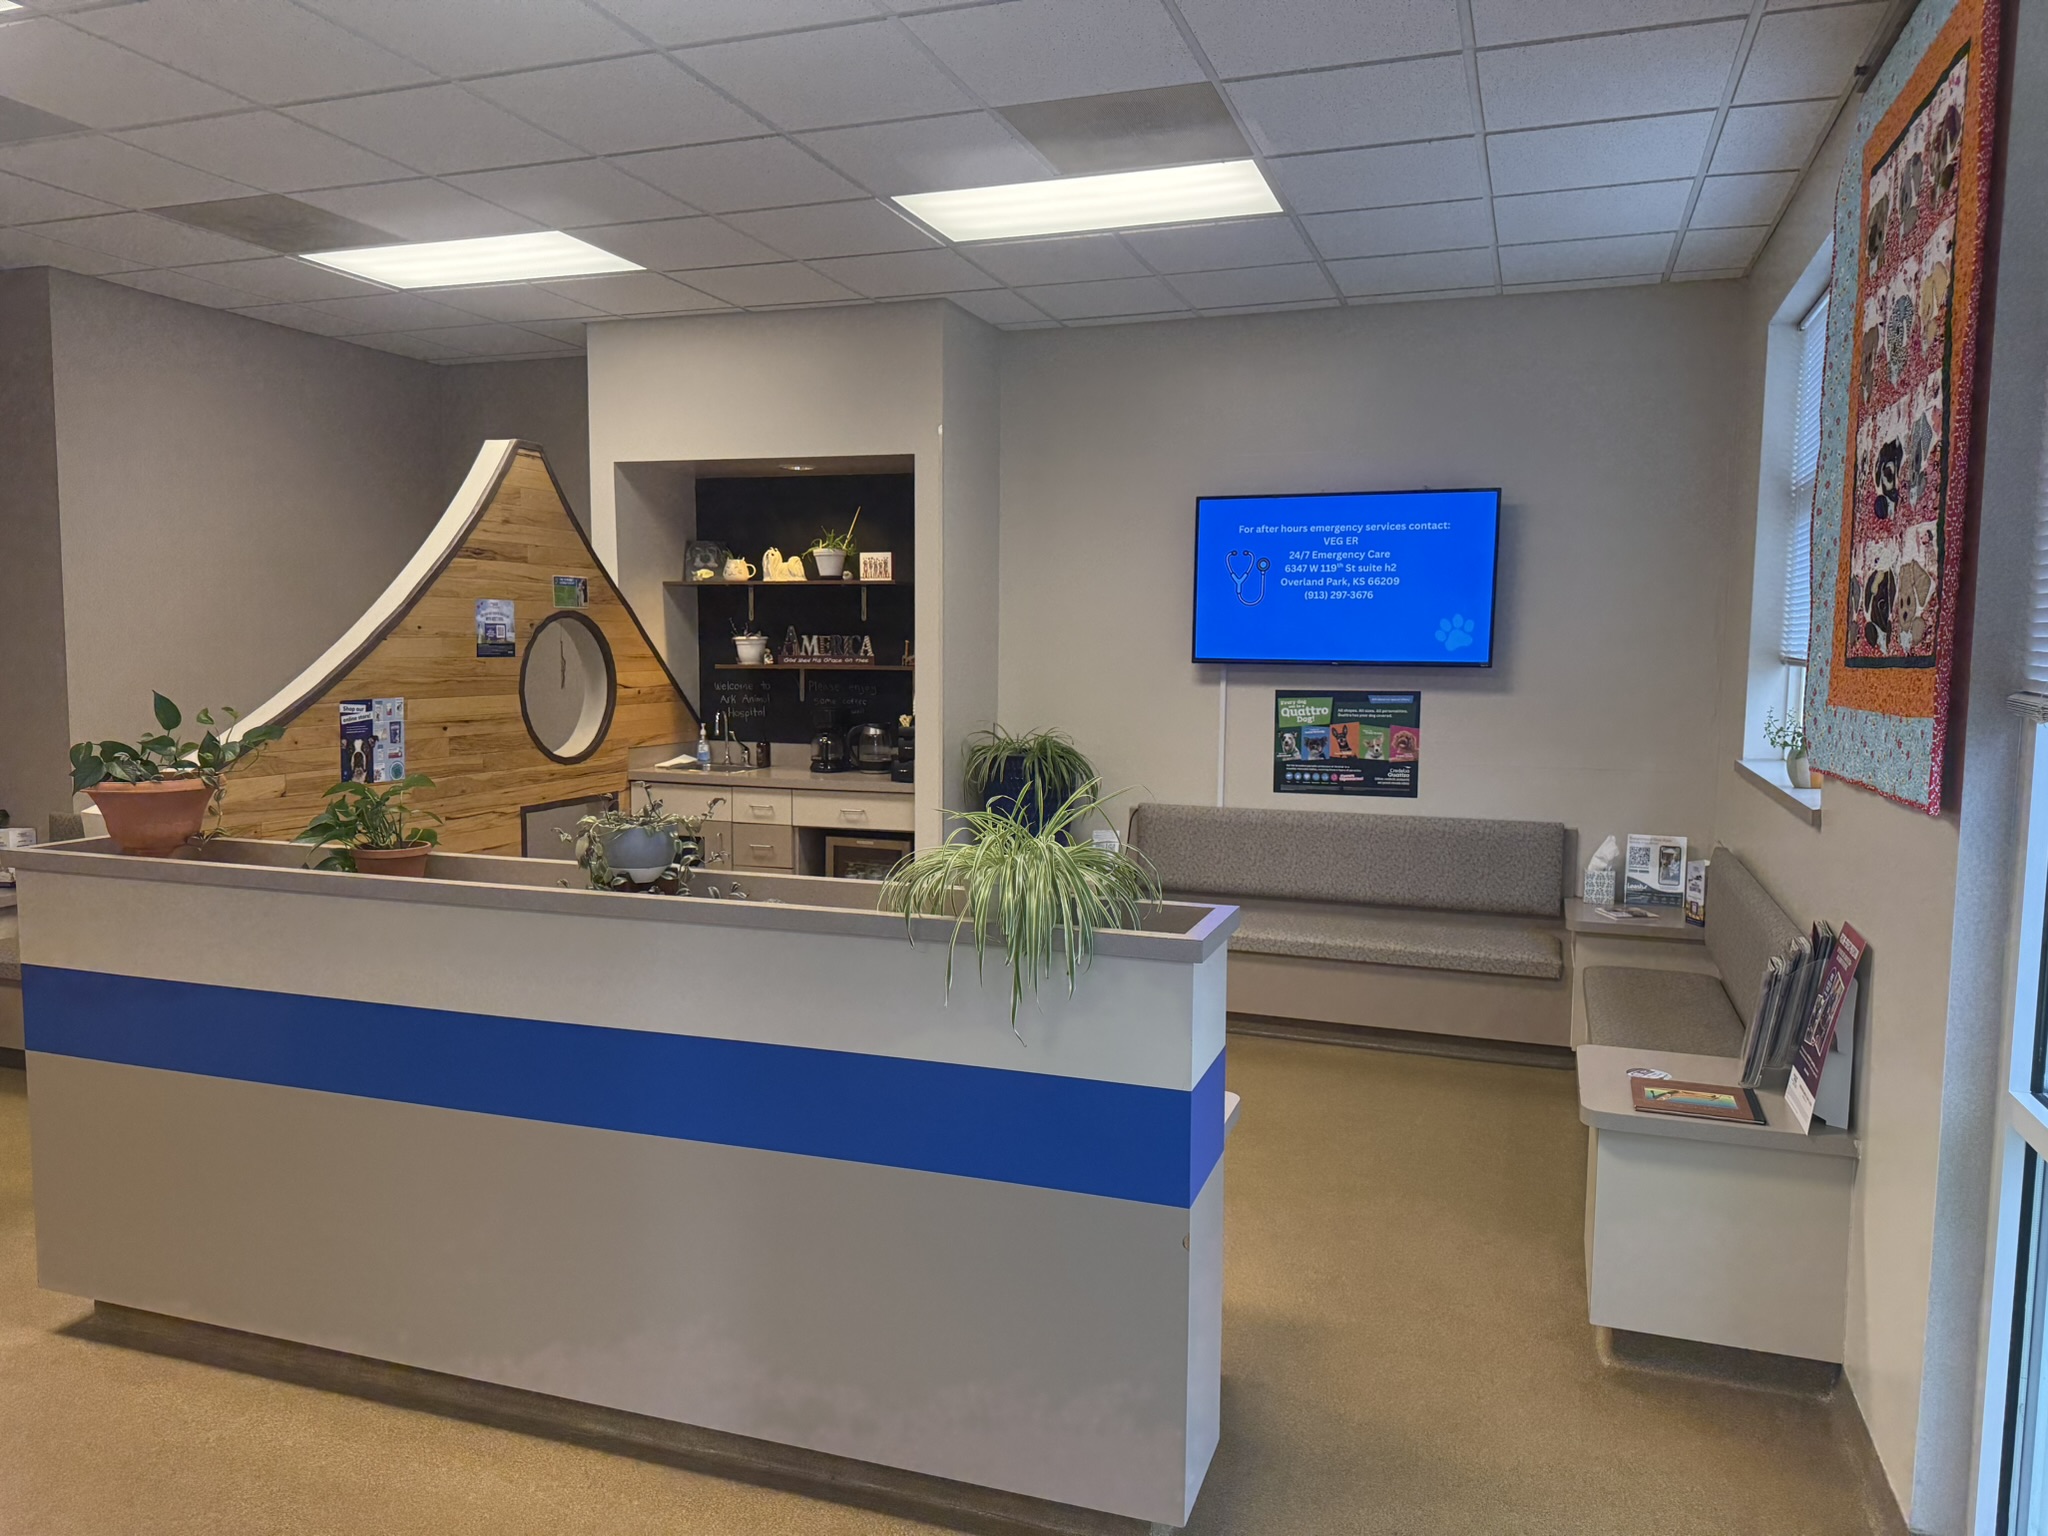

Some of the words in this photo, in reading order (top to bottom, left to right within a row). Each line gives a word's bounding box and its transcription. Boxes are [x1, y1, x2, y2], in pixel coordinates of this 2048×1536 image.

[1239, 525, 1254, 533] For
[1256, 524, 1279, 533] after
[1281, 524, 1308, 533] hours
[1310, 524, 1364, 534] emergency
[1365, 522, 1407, 531] services
[1409, 521, 1451, 530] contact:
[1323, 536, 1343, 546] VEG
[1345, 536, 1359, 545] ER
[1289, 550, 1310, 560] 24/7
[1312, 550, 1366, 561] Emergency
[1367, 549, 1391, 559] Care
[1284, 564, 1307, 573] 6347
[1309, 564, 1319, 573] W
[1345, 563, 1356, 572] St
[1358, 563, 1383, 572] suite
[1384, 563, 1397, 572] h2
[1280, 577, 1324, 586] Overland
[1326, 577, 1351, 587] Park,
[1352, 577, 1366, 585] KS
[1367, 576, 1400, 586] 66209
[1304, 590, 1328, 600] (913)
[1330, 590, 1374, 599] 297-3676
[781, 625, 875, 657] AMERICA
[714, 681, 753, 690] Welcome
[761, 681, 771, 690] to
[727, 706, 766, 722] Hospital
[1281, 706, 1329, 717] Quattro
